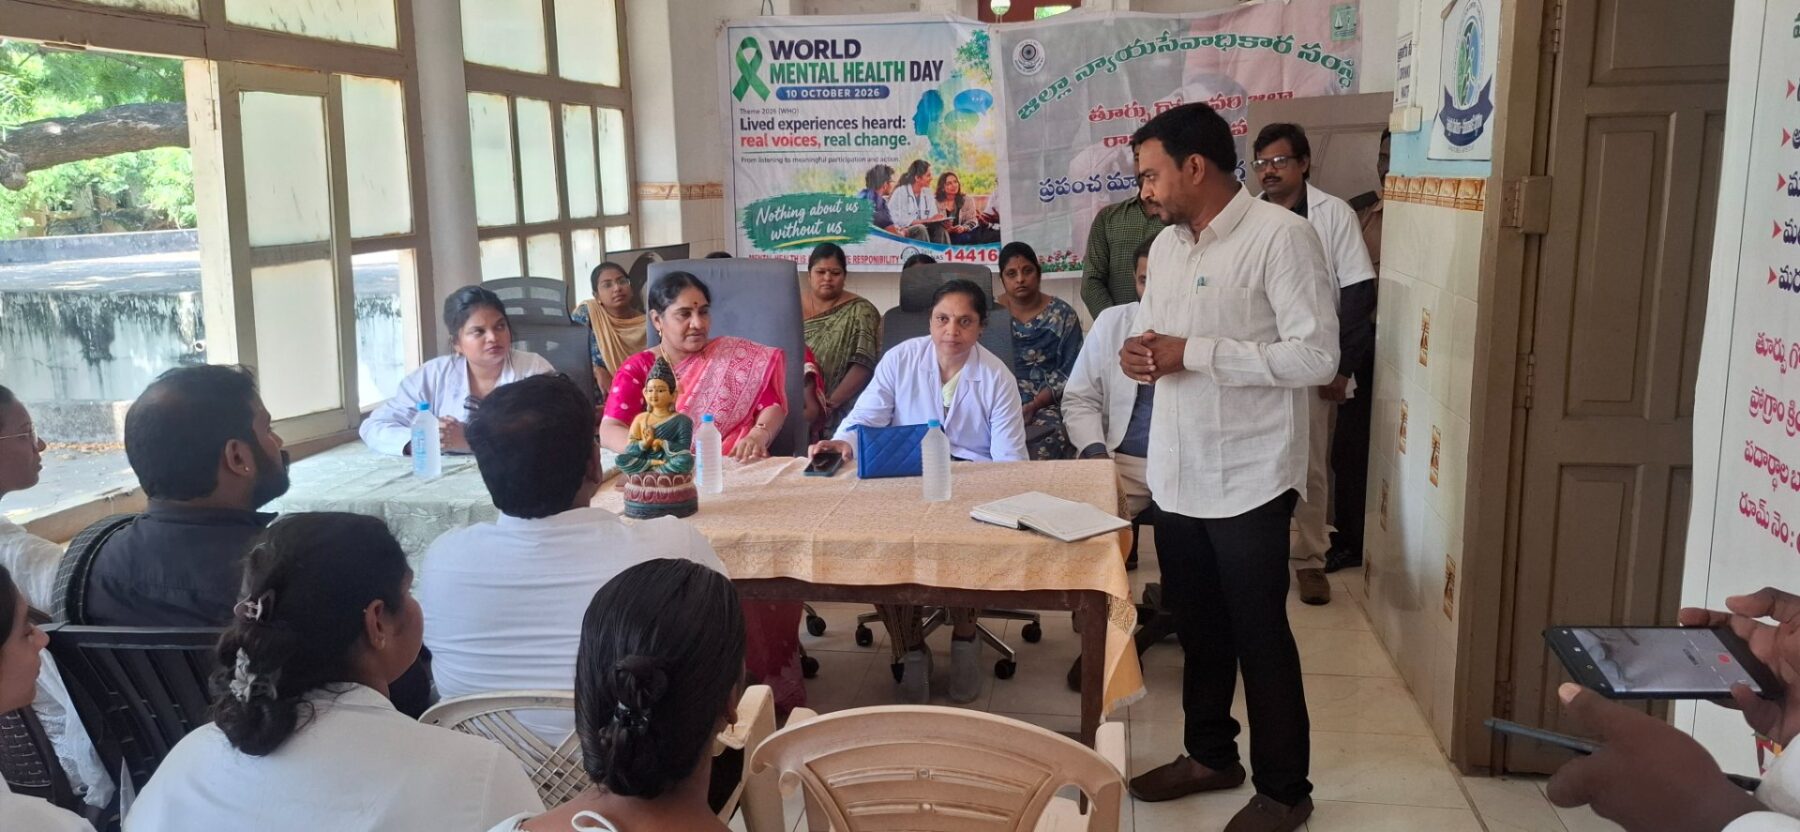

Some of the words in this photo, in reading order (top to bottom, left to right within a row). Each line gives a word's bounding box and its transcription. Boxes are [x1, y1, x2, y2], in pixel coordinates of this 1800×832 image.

[769, 39, 861, 60] WORLD
[770, 62, 839, 84] MENTAL
[843, 61, 905, 83] HEALTH
[910, 60, 943, 81] DAY
[1017, 76, 1072, 120] జిల్లా
[1297, 43, 1354, 88] సంస్థ
[786, 89, 797, 98] 10
[801, 89, 850, 98] OCTOBER
[854, 88, 880, 97] 2026
[740, 117, 774, 131] Lived
[778, 116, 858, 133] experiences
[862, 115, 906, 129] heard:
[740, 133, 768, 147] real
[772, 132, 821, 148] voices,
[824, 132, 850, 146] real
[854, 132, 911, 150] change.
[1039, 174, 1101, 202] ప్రపంచ
[756, 204, 805, 226] Nothing
[810, 199, 842, 216] about
[845, 201, 859, 213] us
[770, 219, 823, 241] without
[826, 221, 847, 234] us.
[945, 249, 998, 262] 14416
[1755, 332, 1787, 374] తూర్పు
